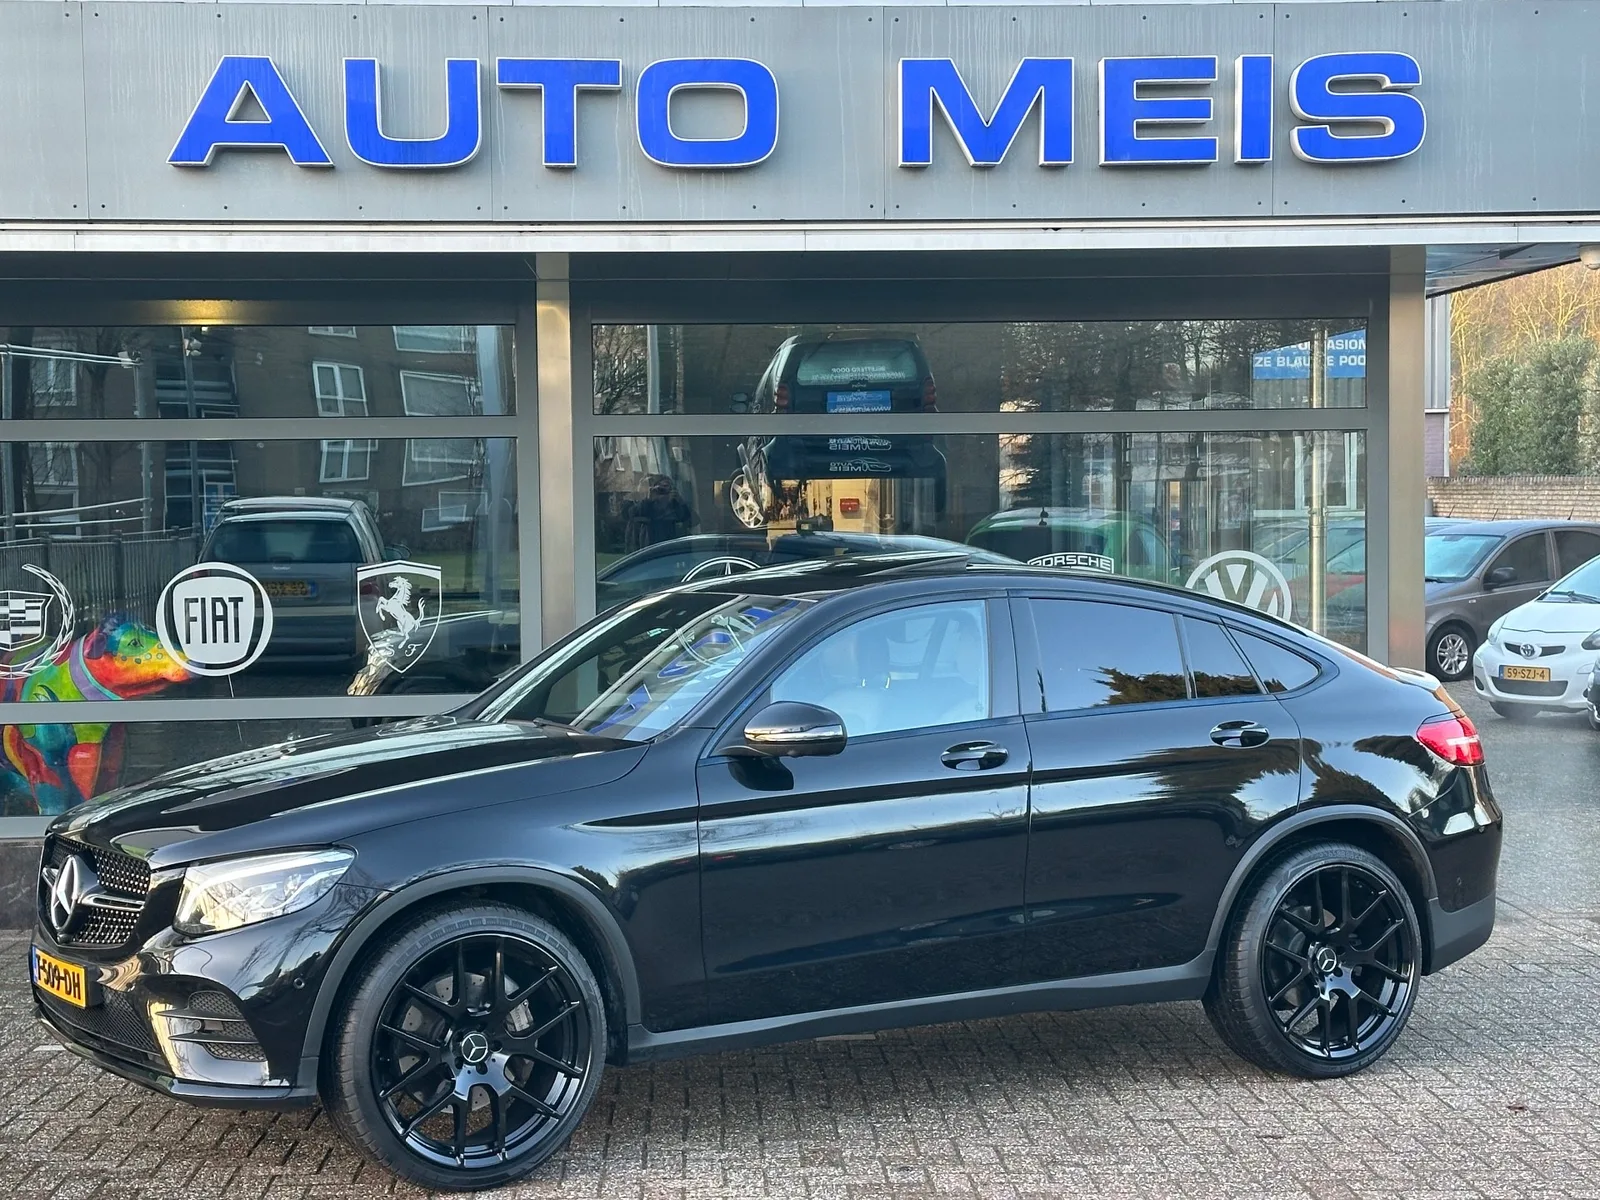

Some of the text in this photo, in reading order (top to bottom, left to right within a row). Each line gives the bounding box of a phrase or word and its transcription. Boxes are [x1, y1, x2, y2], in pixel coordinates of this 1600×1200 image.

[167, 51, 1427, 169] AUTO MEIS
[1276, 355, 1335, 367] BLAUE
[184, 596, 244, 645] FIAT
[1507, 667, 1546, 680] 59-SZJ-4
